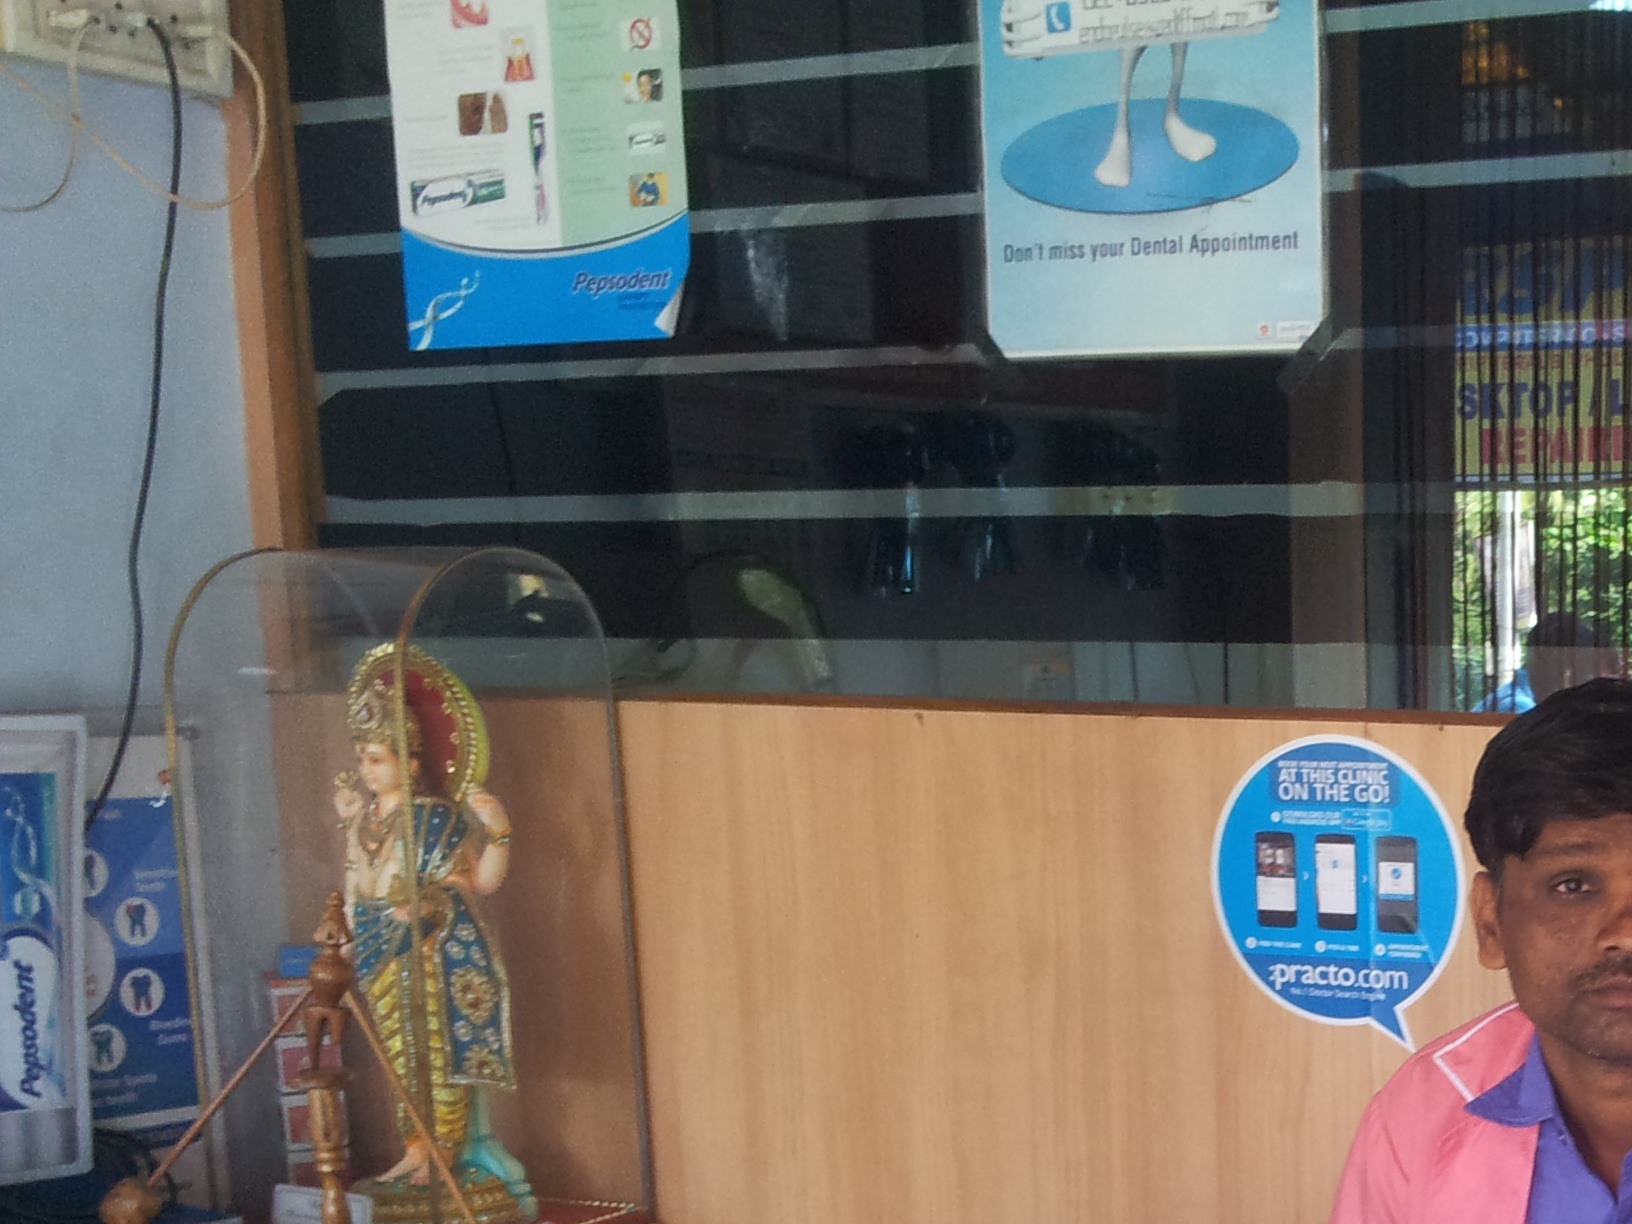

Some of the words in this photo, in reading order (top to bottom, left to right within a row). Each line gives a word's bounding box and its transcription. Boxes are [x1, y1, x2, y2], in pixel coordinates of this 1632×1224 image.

[1003, 243, 1044, 263] Don't
[1048, 241, 1085, 261] miss
[1090, 240, 1125, 263] your
[1130, 235, 1184, 256] Dental
[1189, 231, 1299, 258] Appointment
[571, 269, 673, 300] Pepsodent
[1278, 768, 1298, 783] AT
[1300, 768, 1336, 784] THIS
[1337, 769, 1390, 785] CLINIC
[1278, 782, 1310, 801] ON
[1312, 783, 1351, 802] THE
[1353, 784, 1391, 804] GO!
[1270, 963, 1409, 991] practo.com
[16, 958, 46, 1098] Pepsodent
